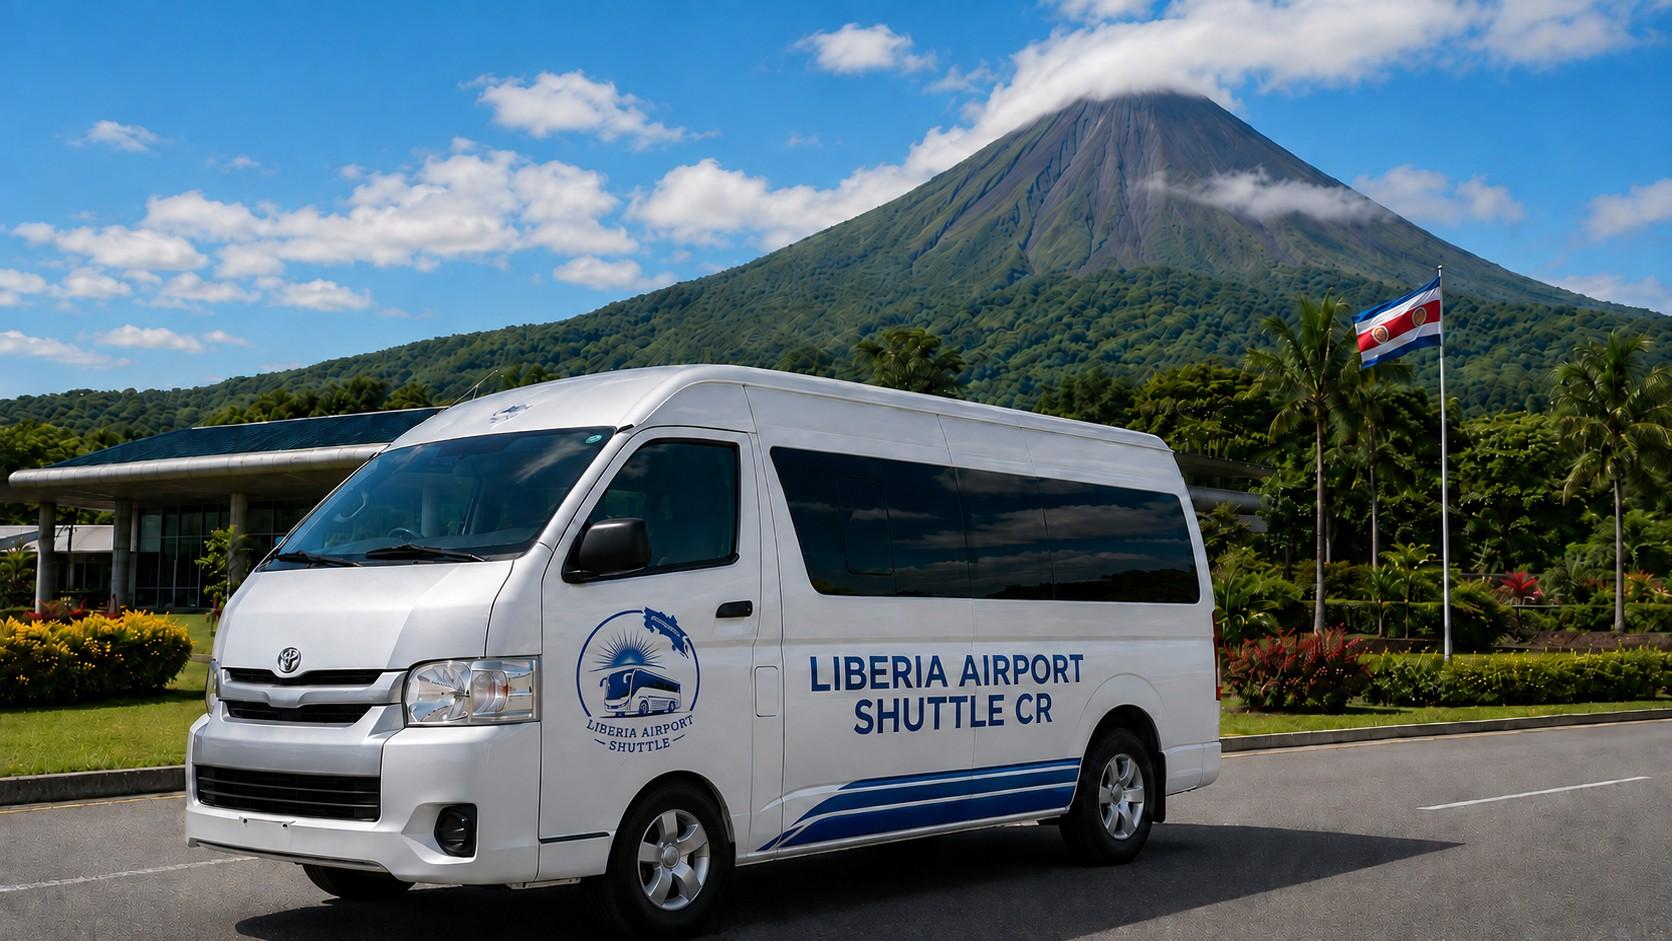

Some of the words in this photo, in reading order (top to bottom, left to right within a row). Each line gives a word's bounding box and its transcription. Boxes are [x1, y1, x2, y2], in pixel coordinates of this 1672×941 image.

[809, 655, 949, 691] LIBERIA
[959, 654, 1084, 687] AIRPORT
[586, 720, 637, 738] LIBERIA
[642, 715, 694, 737] AIRPORT
[854, 694, 1005, 734] SHUTTLE
[1015, 693, 1053, 724] CR
[609, 738, 670, 752] SHUTTLE
